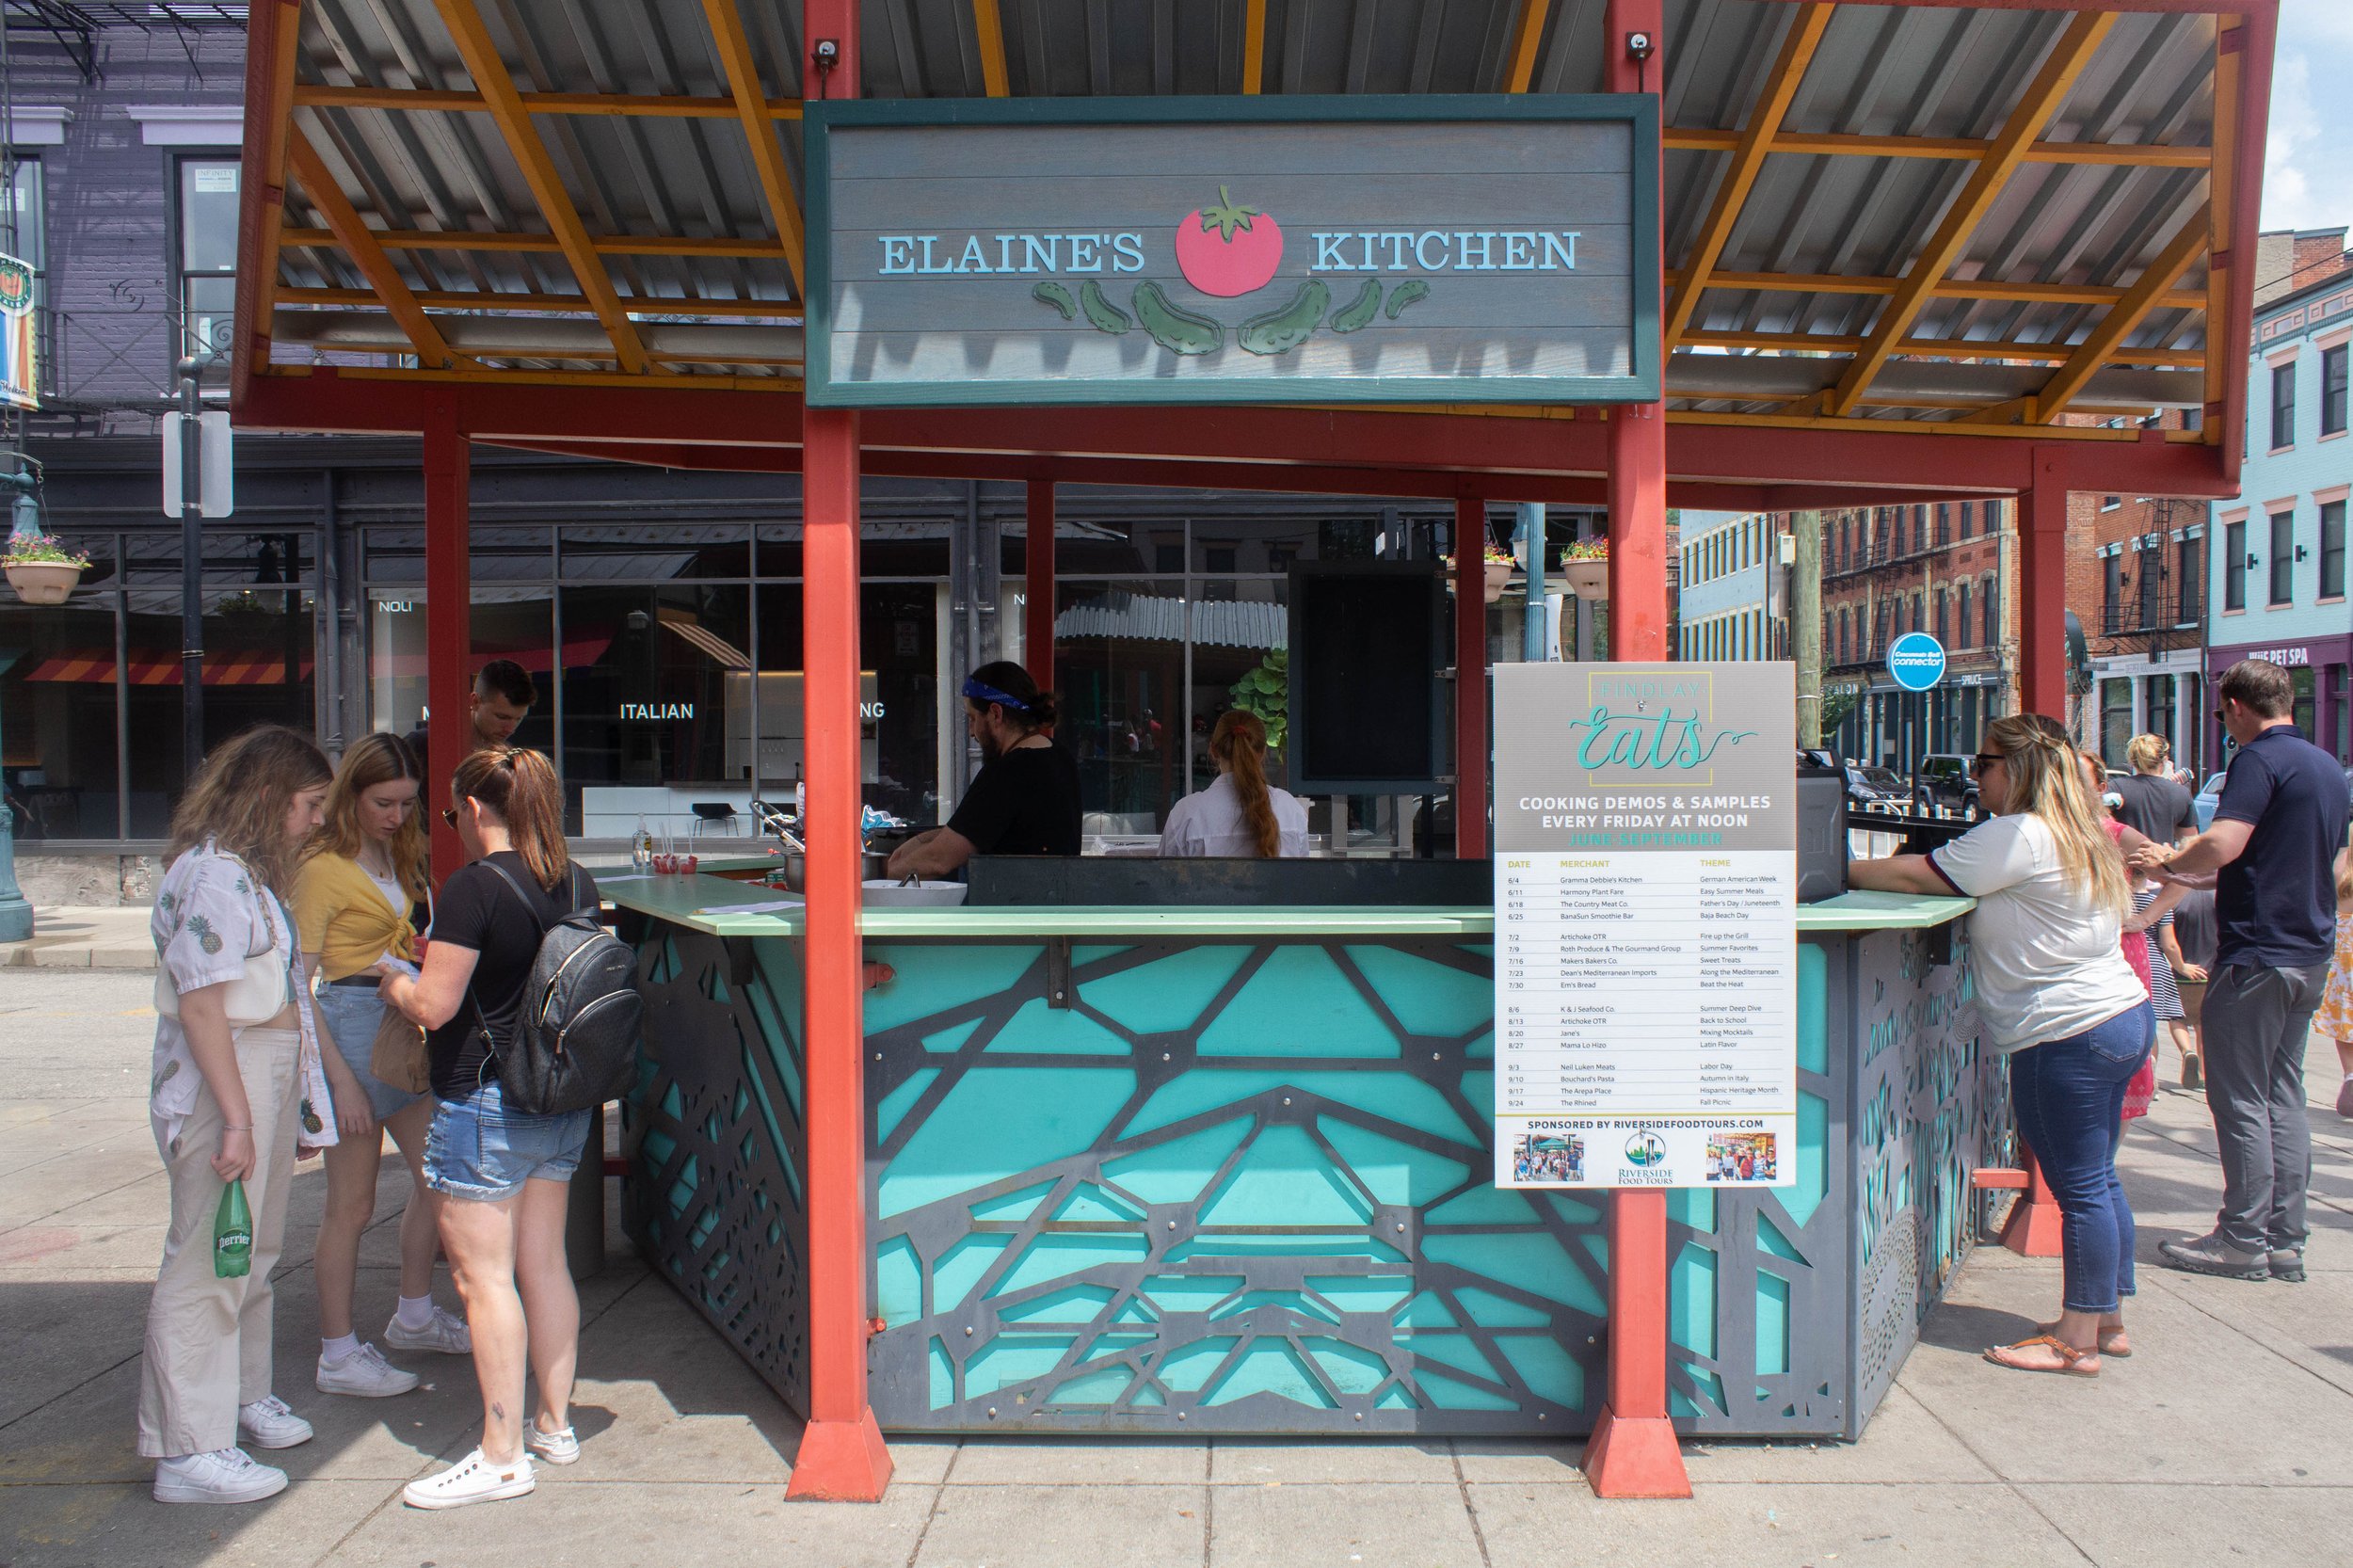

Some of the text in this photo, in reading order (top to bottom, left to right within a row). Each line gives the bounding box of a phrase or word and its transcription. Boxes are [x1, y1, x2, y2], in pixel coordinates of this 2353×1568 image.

[878, 231, 1579, 275] ELAINE'S KITCHEN
[379, 601, 412, 612] NOLI
[2270, 649, 2287, 665] PET
[2289, 648, 2308, 664] SPA
[1961, 674, 1981, 685] SPRUCE
[1600, 682, 1701, 697] FINDLAY
[1833, 684, 1859, 695] ALON
[619, 704, 694, 720] ITALIAN
[1570, 705, 1758, 770] Eats
[1519, 795, 1771, 811] COOKING DEMOS & SAMPLES
[1542, 813, 1749, 829] EVERY FRIDAY AT NOON
[1569, 833, 1722, 847] JUNE-SEPTEMBER
[1528, 1121, 1593, 1129] SPONSORED
[1614, 1120, 1764, 1128] RIVERSIDEFOODTOURS.COM
[1618, 1169, 1673, 1177] RIVERSIDE
